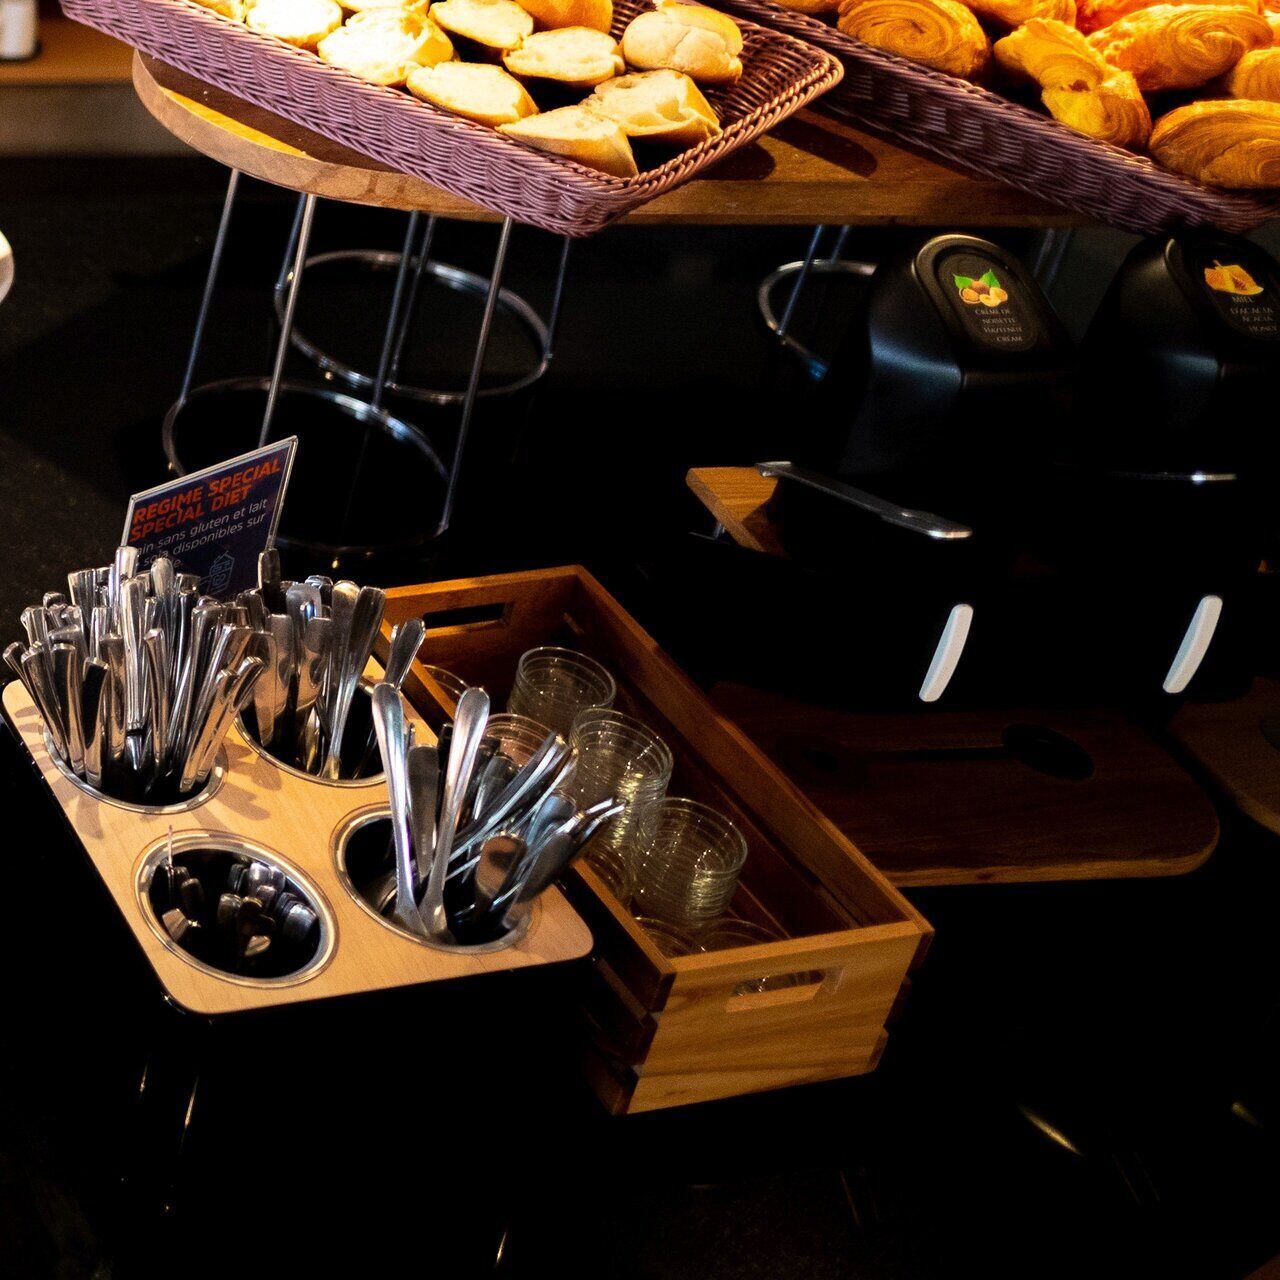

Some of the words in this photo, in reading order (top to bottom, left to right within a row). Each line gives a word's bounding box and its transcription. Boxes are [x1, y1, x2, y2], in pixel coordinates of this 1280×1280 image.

[129, 503, 205, 542] SPECIAL
[211, 484, 252, 512] DIET
[133, 486, 203, 524] REGIME
[207, 458, 281, 497] SPECIAL
[157, 530, 186, 548] sans
[190, 514, 229, 537] gluten
[233, 507, 246, 520] et
[248, 498, 268, 514] lait
[172, 522, 243, 555] disponibles
[246, 513, 266, 529] sur
